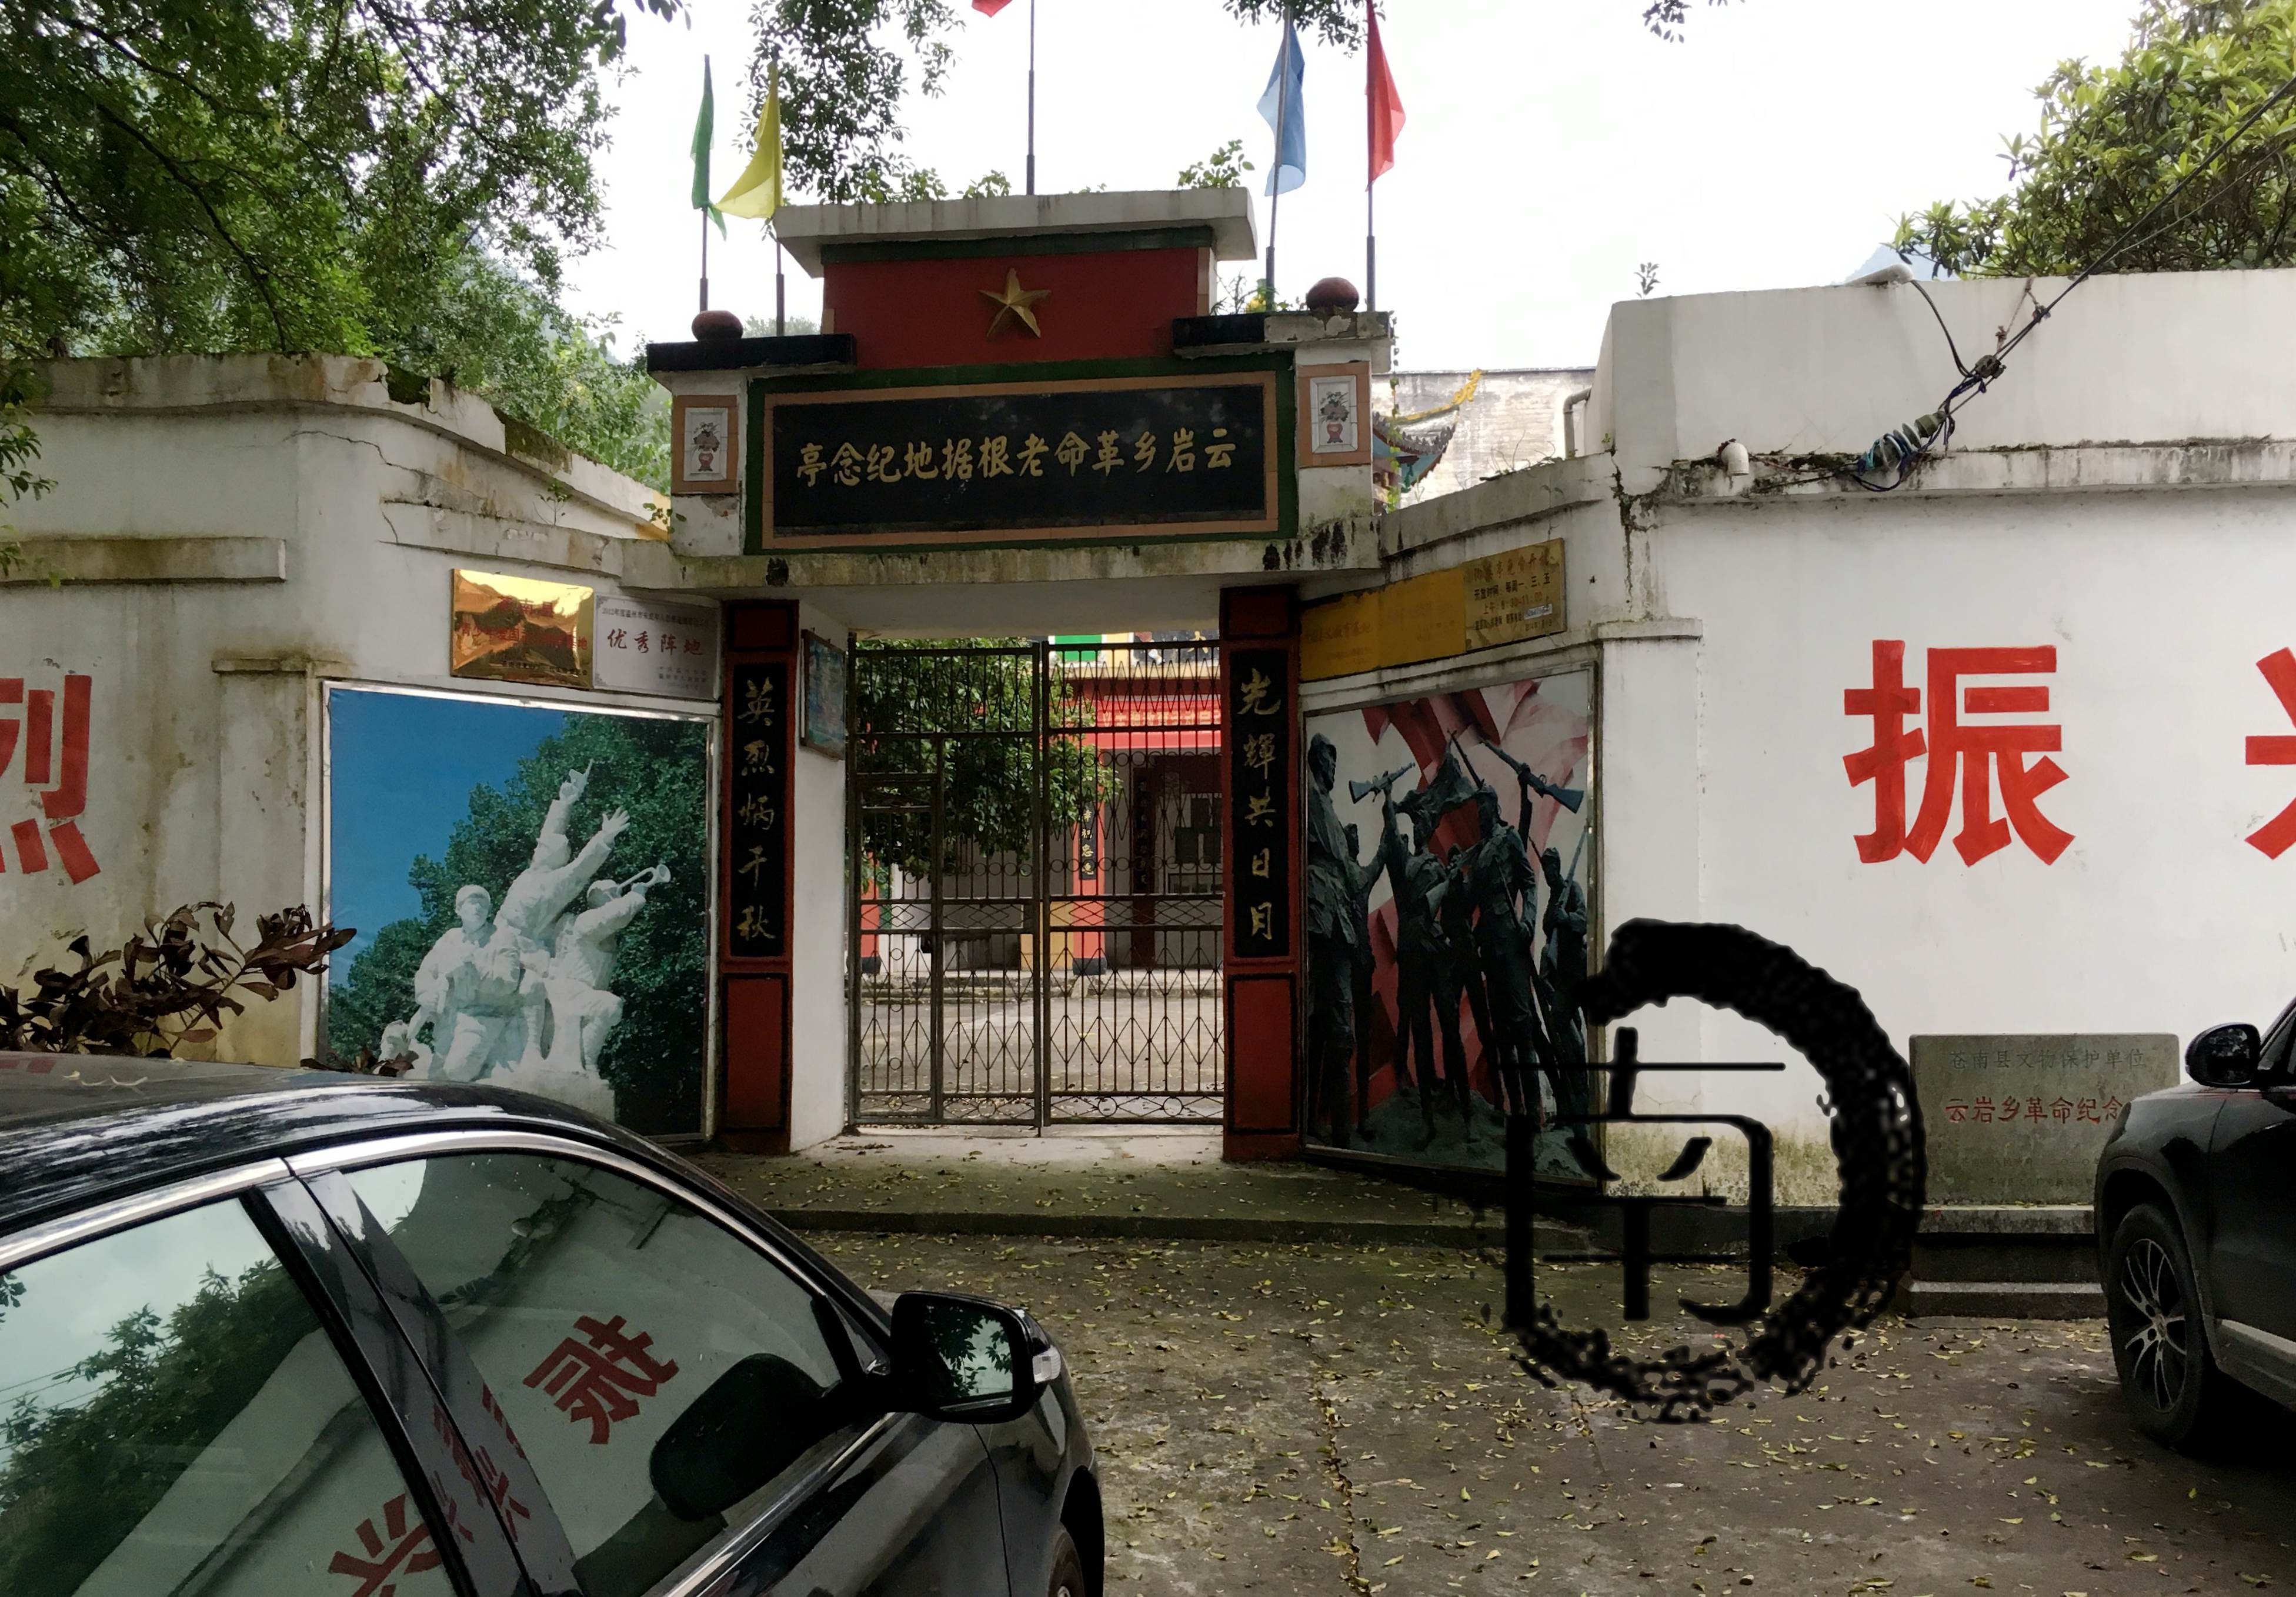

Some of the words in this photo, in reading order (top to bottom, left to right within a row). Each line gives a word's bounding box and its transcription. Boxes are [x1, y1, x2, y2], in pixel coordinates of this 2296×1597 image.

[796, 425, 1238, 488] 云岩乡革命老根据地纪念亭
[607, 628, 703, 656] 优秀阵地
[1949, 1049, 2147, 1070] 苍南县文物保护单位
